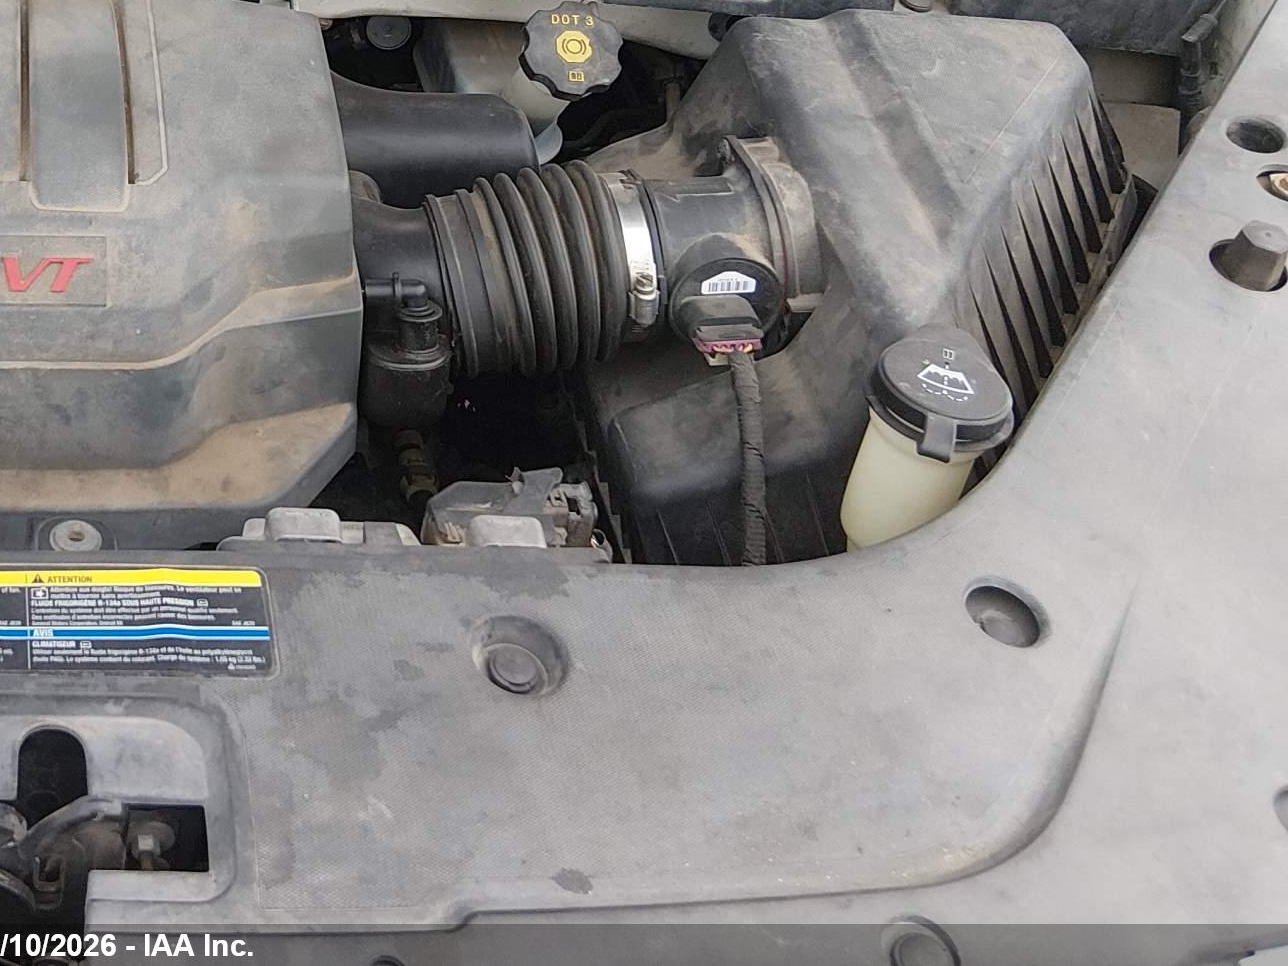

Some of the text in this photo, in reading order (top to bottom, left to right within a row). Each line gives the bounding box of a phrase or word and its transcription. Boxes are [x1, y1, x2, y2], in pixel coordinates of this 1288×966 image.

[551, 14, 594, 26] DOT 3
[47, 575, 93, 583] ATTENTION
